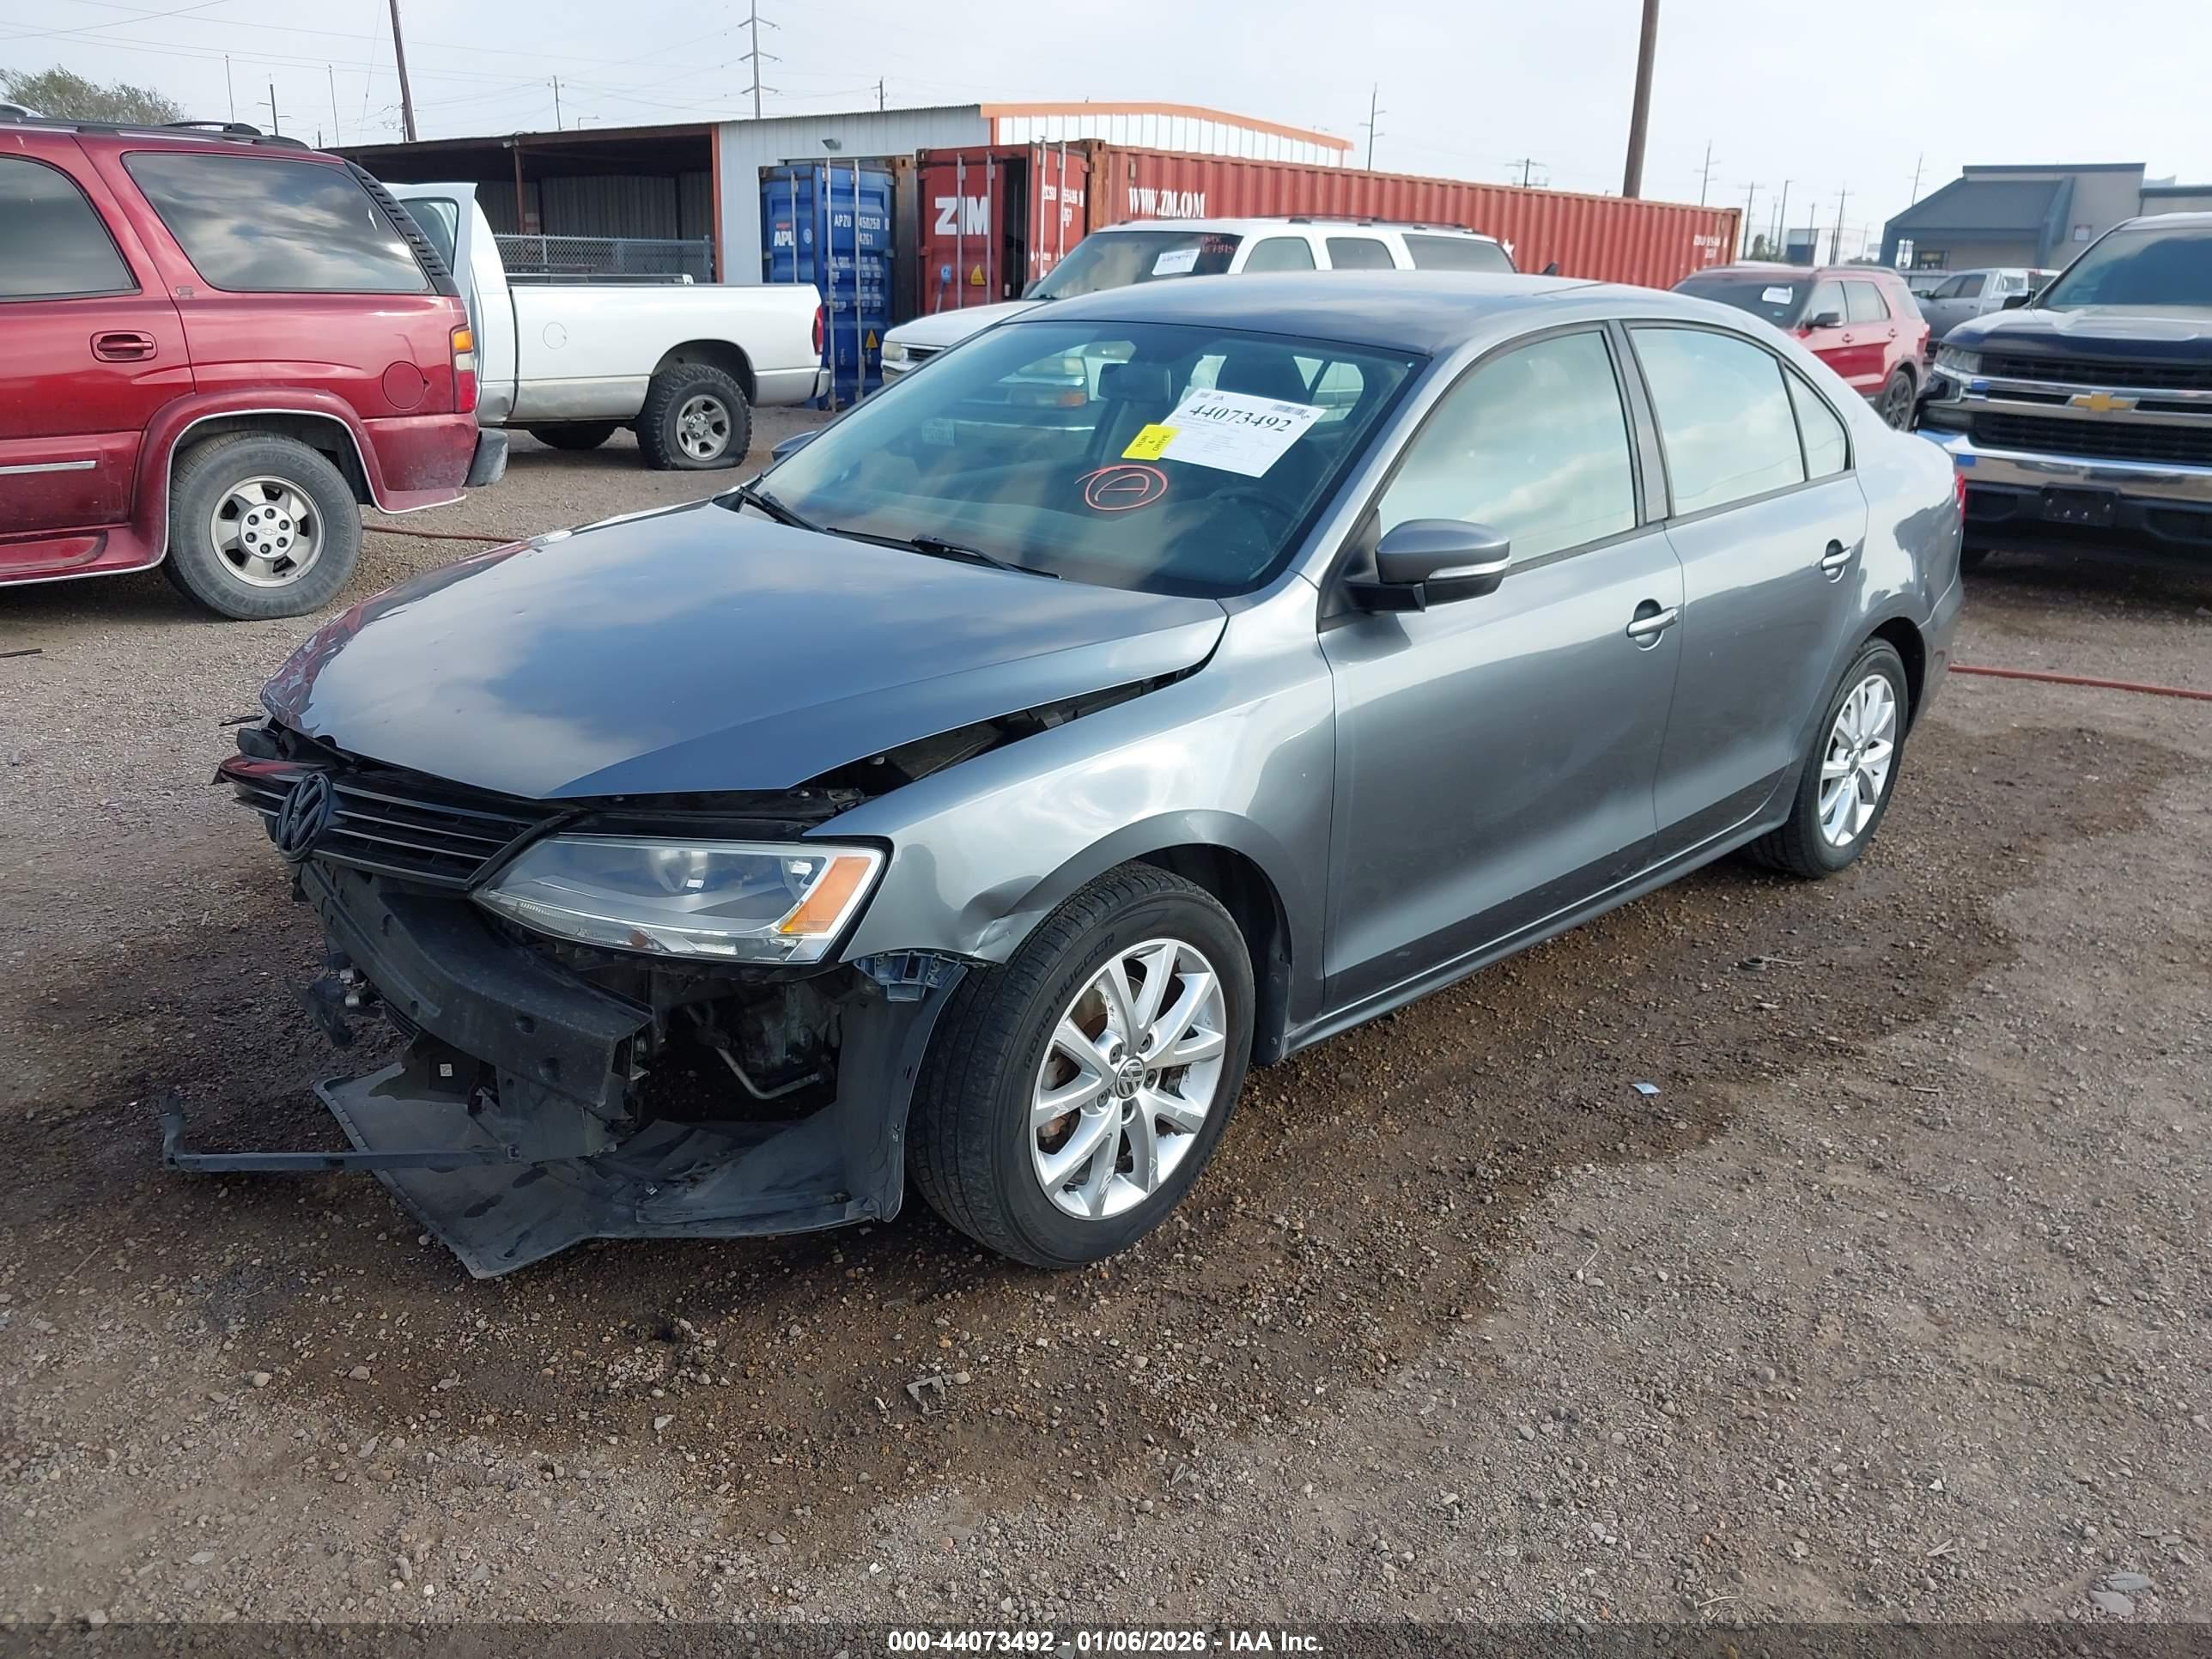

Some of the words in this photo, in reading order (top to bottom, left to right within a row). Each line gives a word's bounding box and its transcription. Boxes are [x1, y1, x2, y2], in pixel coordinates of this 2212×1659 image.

[834, 214, 852, 228] APZU
[934, 196, 989, 235] ZIM
[774, 230, 795, 246] APL
[1188, 404, 1292, 432] 44073492
[1024, 1006, 1054, 1071] ROAD
[1054, 932, 1115, 1006] HUGGER
